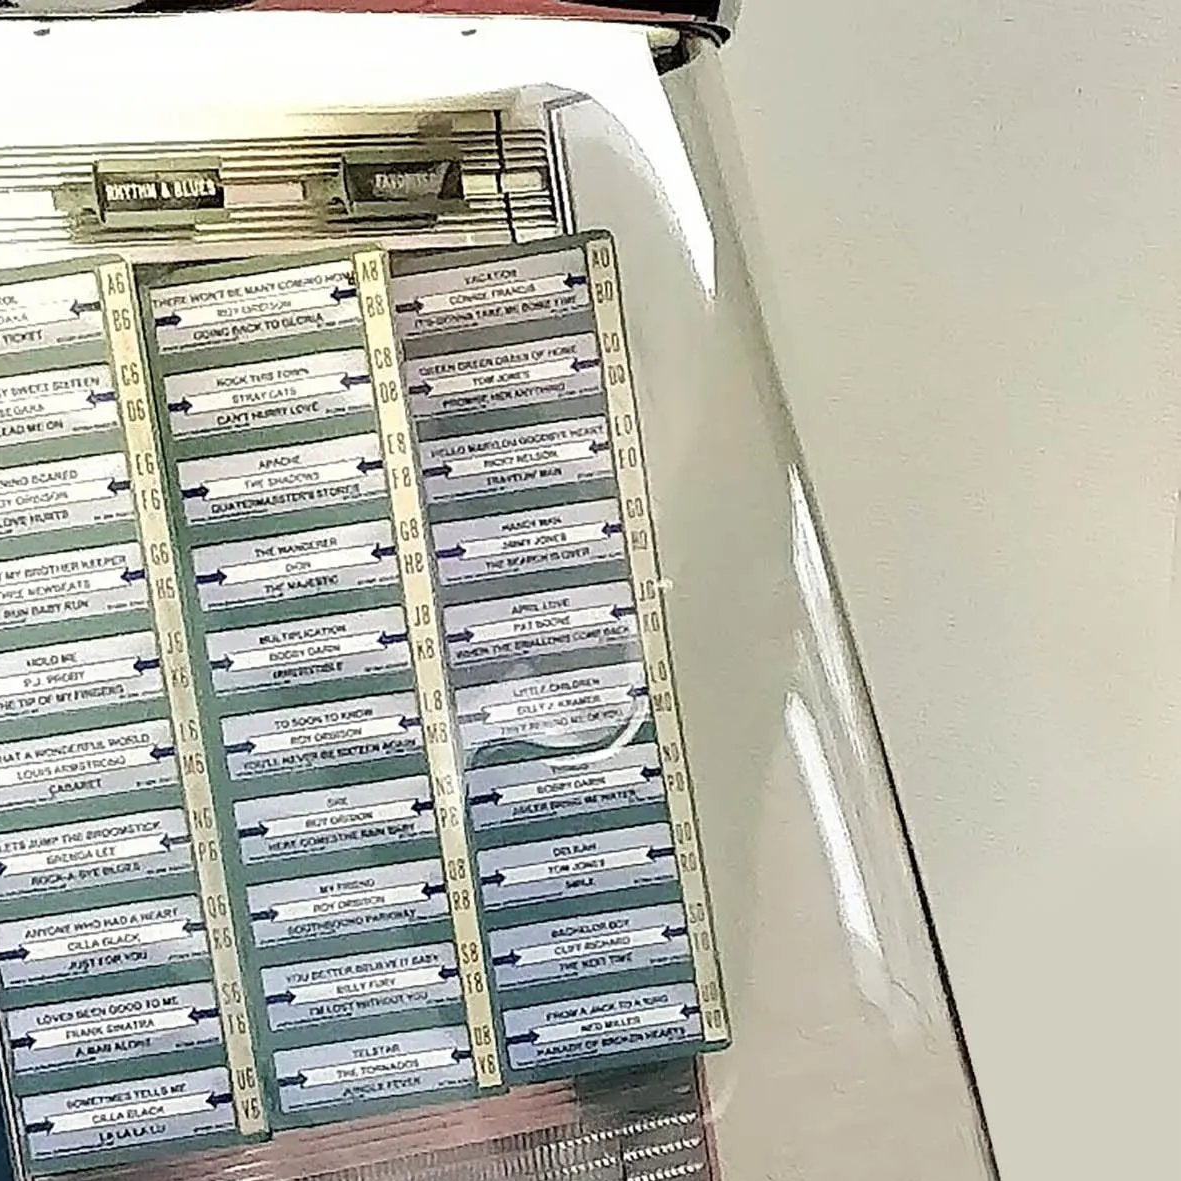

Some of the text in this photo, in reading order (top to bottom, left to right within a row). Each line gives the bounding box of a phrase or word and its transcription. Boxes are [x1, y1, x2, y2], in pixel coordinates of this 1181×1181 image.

[105, 178, 217, 202] RHYTHM & BLUES
[108, 272, 125, 295] A6
[374, 347, 392, 369] C8
[392, 467, 411, 489] F8
[401, 518, 419, 541] G8
[462, 942, 479, 965] S8
